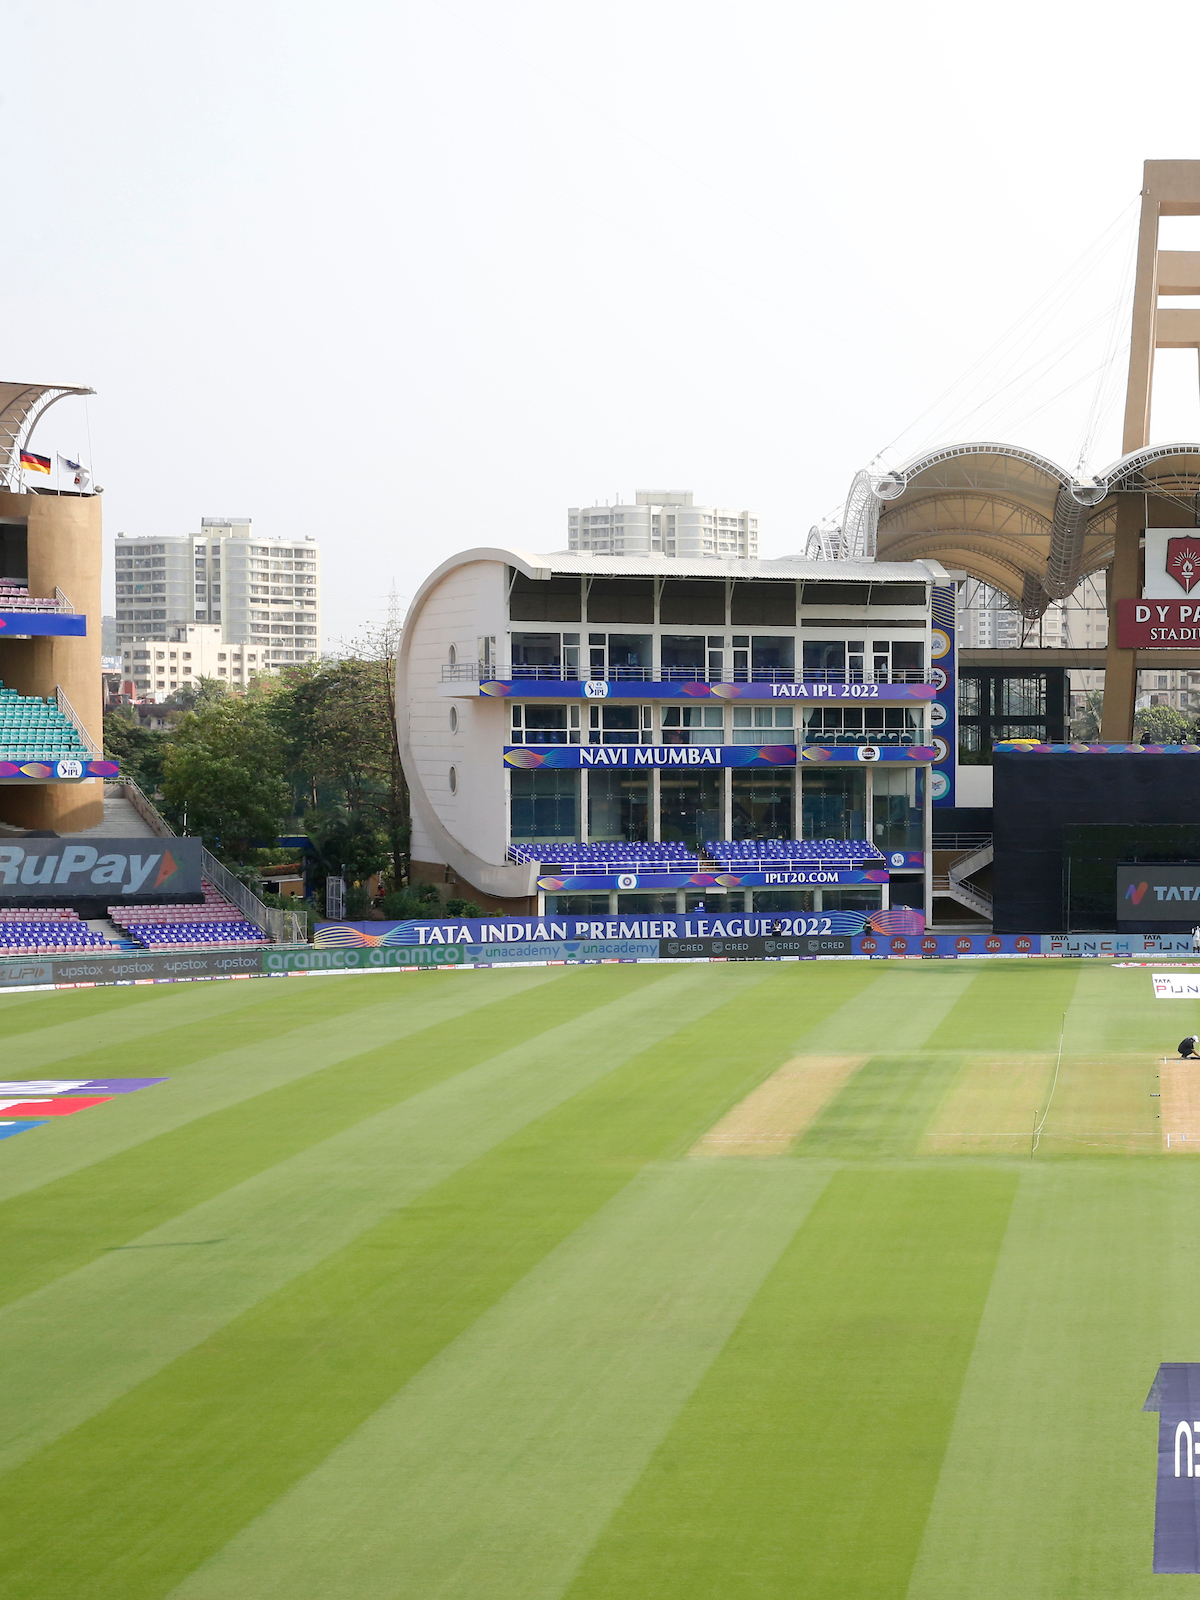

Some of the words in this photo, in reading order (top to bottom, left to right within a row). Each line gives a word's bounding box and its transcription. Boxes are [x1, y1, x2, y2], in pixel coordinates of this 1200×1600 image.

[1135, 605, 1151, 623] D
[1155, 605, 1171, 623] Y
[770, 684, 808, 697] TATA
[812, 684, 836, 697] IPL
[840, 684, 879, 697] 2022
[579, 749, 628, 765] NAVI
[633, 748, 722, 765] MUMBAI
[67, 768, 80, 776] IPL
[0, 845, 161, 894] RuPay
[765, 871, 840, 885] IPLT20.COM
[413, 925, 474, 945] TATA
[480, 922, 568, 942] INDIAN
[574, 920, 678, 941] PREMIER
[684, 918, 773, 938] LEAGUE
[780, 917, 832, 936] 2022
[582, 939, 658, 956] unacademy
[680, 943, 704, 952] CRED
[725, 943, 749, 951] CRED
[776, 942, 800, 950] CRED
[821, 941, 844, 950] CRED
[862, 940, 876, 950] Jio
[892, 940, 906, 949] Jio
[922, 940, 937, 949] Jio
[956, 940, 971, 949] Jio
[986, 940, 1001, 949] Jio
[1016, 940, 1031, 949] Jio
[1050, 941, 1129, 951] PUNCH
[369, 946, 459, 966] aramco
[485, 944, 561, 961] unacademy
[214, 956, 258, 971] upstox
[267, 950, 360, 969] aramco
[58, 964, 103, 979] upstox
[109, 962, 155, 976] upstox
[164, 960, 208, 974] upstox
